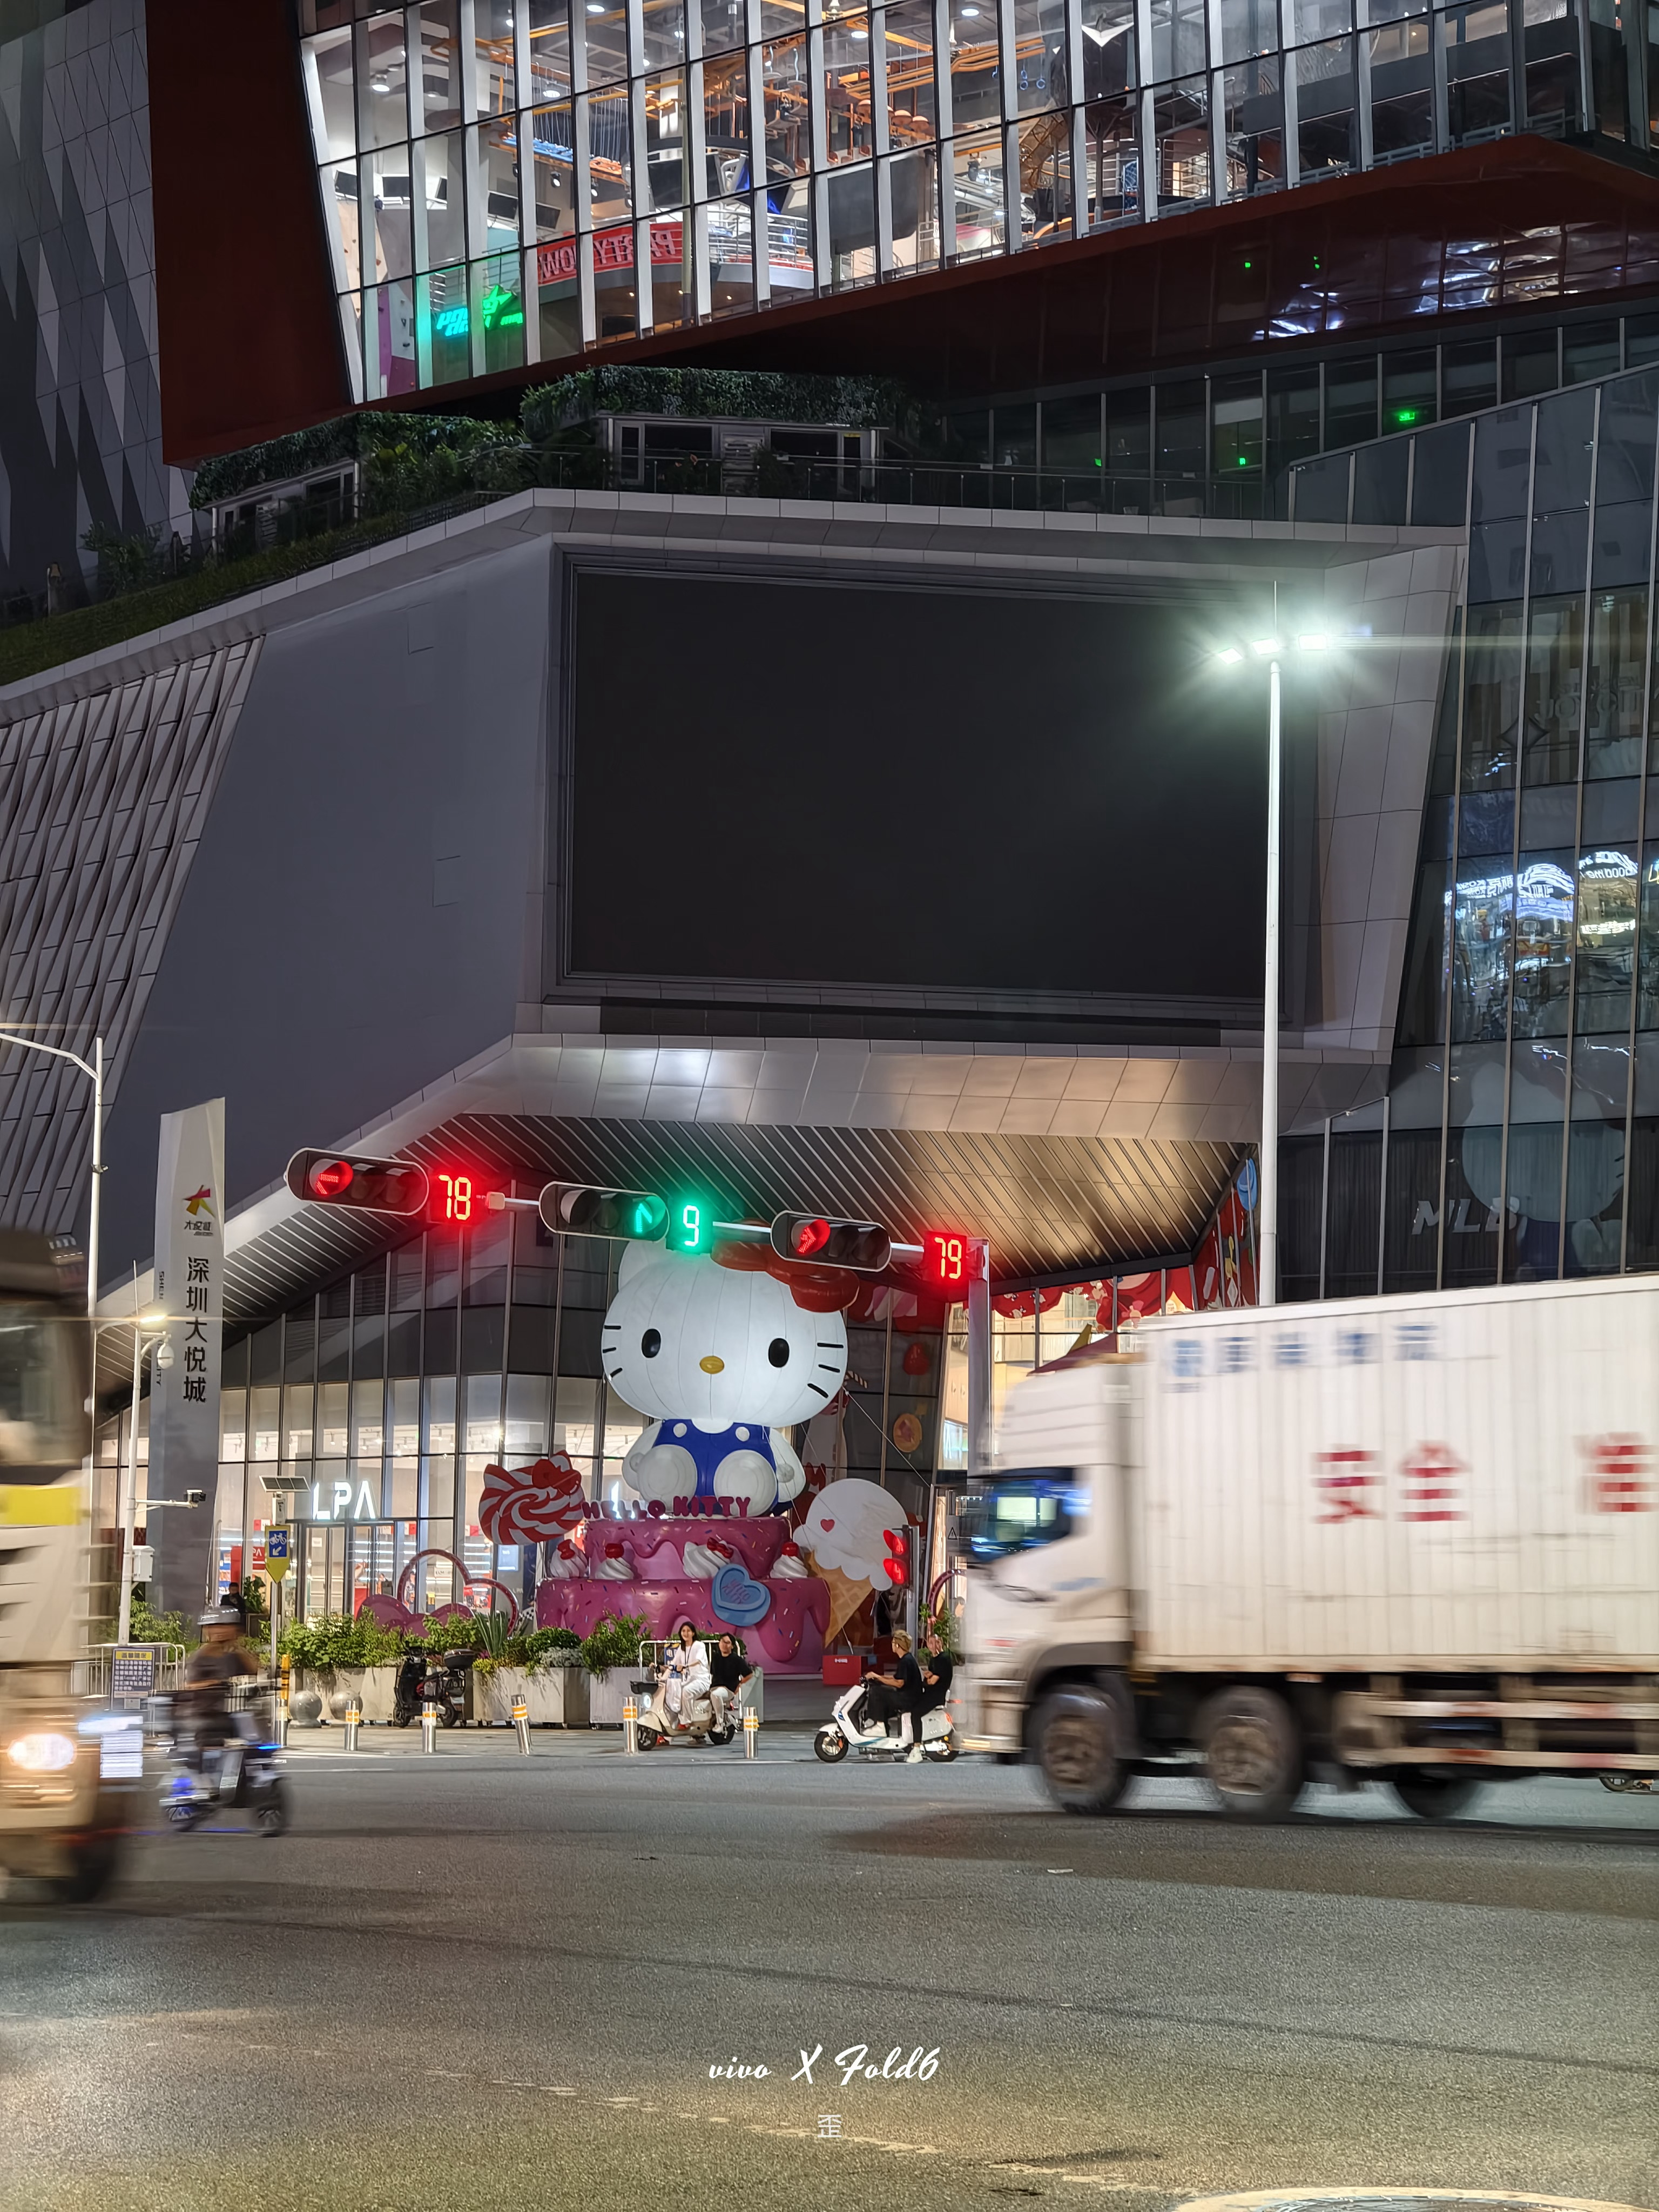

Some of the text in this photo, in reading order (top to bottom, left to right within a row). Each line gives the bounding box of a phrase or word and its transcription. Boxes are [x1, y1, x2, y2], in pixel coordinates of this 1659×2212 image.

[683, 1205, 700, 1247] 9
[934, 1237, 962, 1279] 79
[183, 1256, 210, 1404] 深圳大悦城
[312, 1480, 376, 1521] LPA
[582, 1495, 751, 1520] HELLO KITTY
